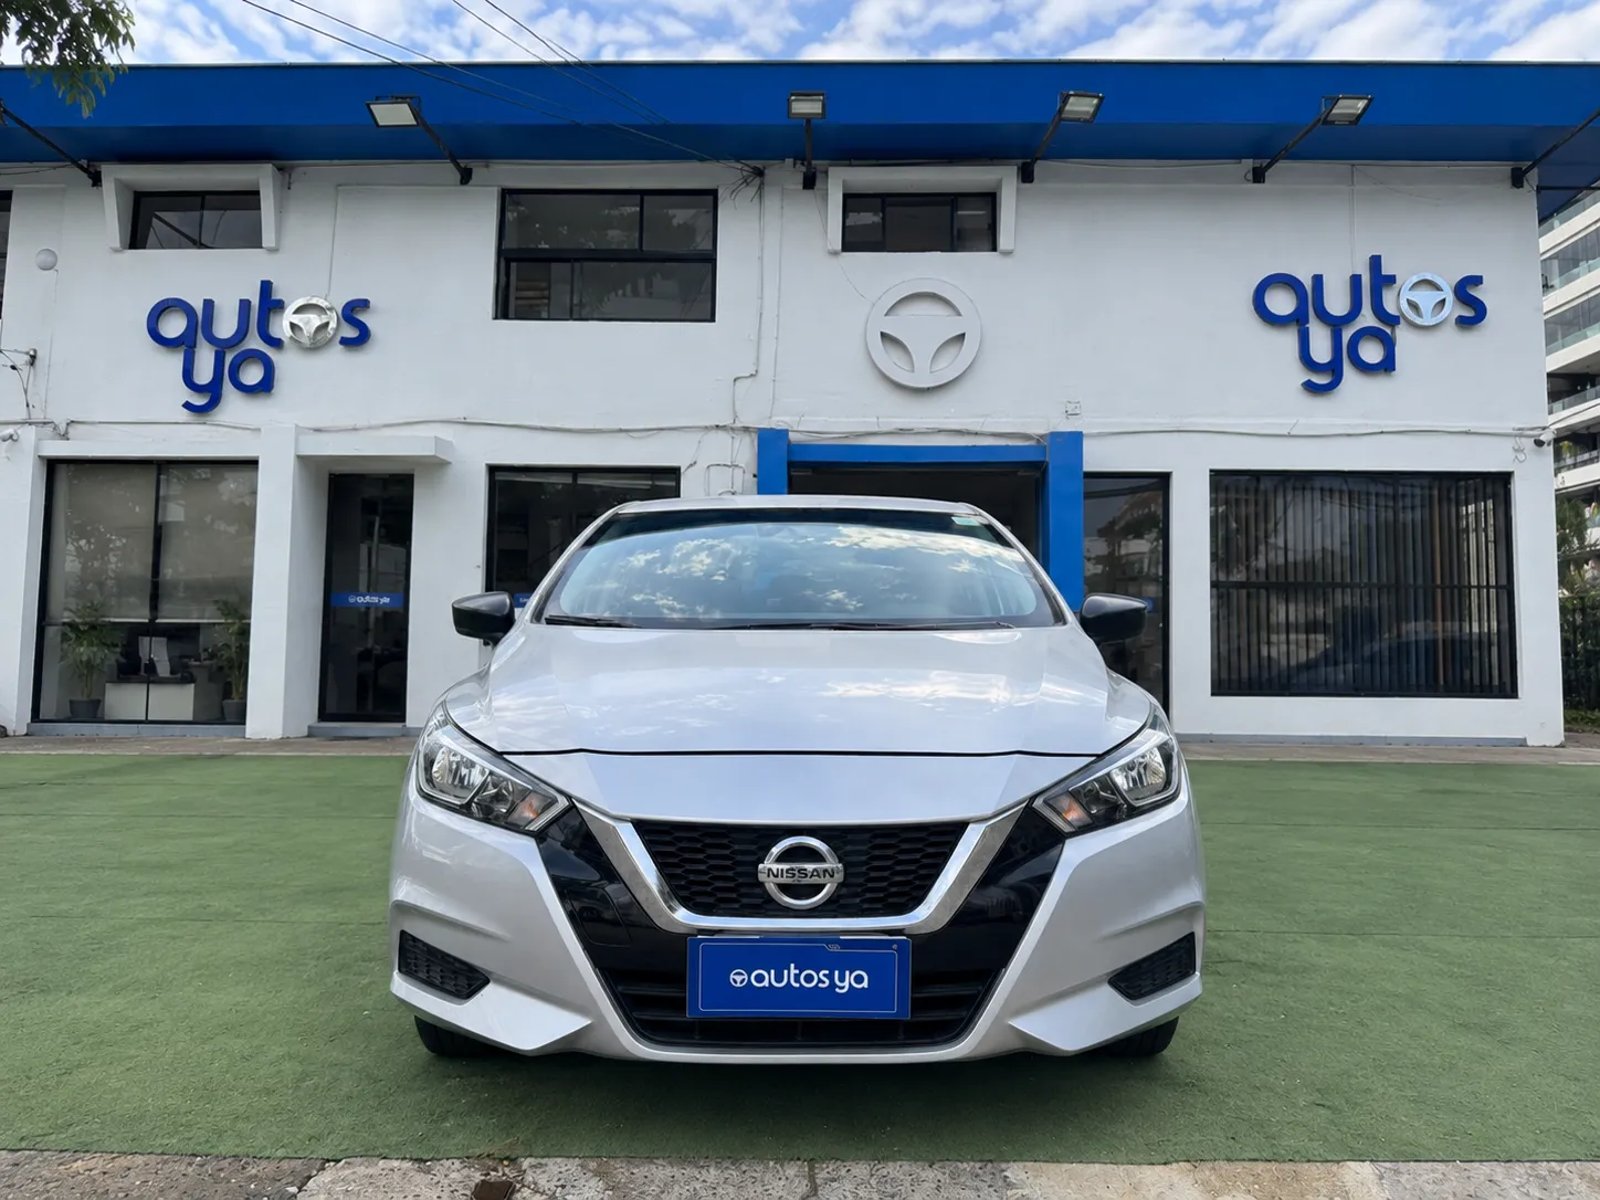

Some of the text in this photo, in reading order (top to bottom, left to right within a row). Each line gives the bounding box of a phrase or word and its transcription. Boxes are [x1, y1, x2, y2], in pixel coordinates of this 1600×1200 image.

[147, 280, 372, 349] autos
[1252, 254, 1488, 328] autos
[181, 348, 276, 414] ya
[1298, 325, 1396, 393] ya
[766, 867, 835, 879] NISSAN
[750, 963, 869, 994] autos ya
